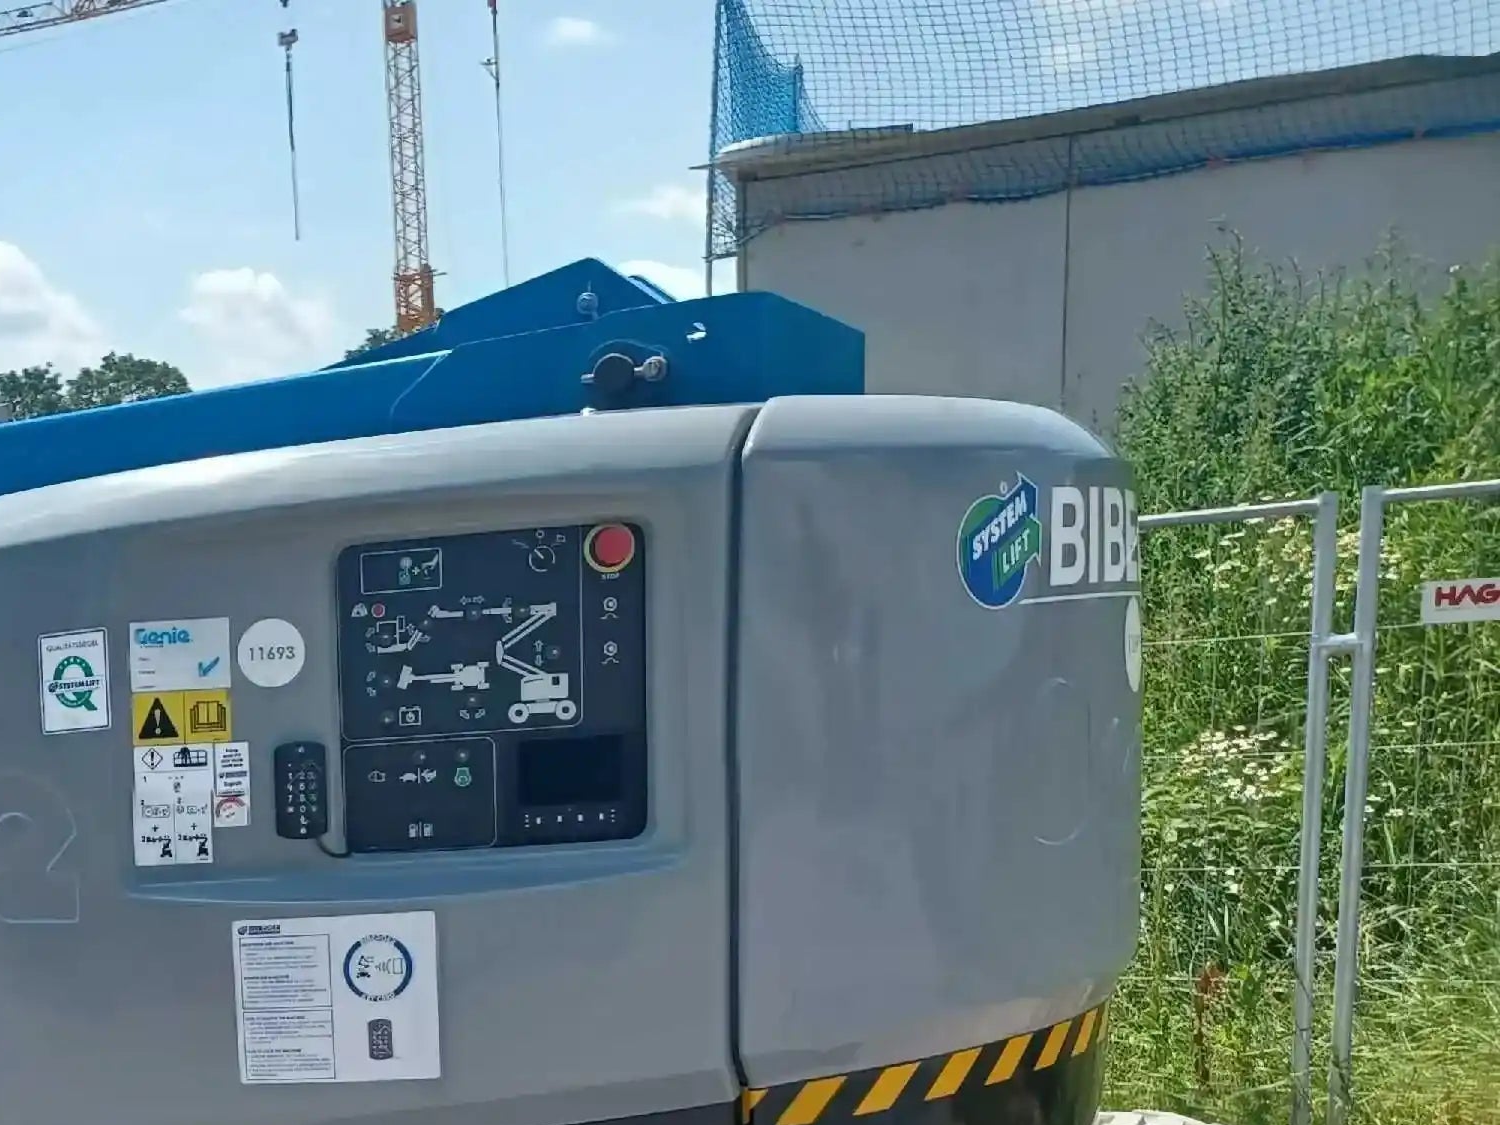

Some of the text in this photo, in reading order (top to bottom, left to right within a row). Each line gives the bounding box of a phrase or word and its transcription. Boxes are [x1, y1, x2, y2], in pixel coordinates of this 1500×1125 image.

[972, 490, 1028, 561] SYSTEM
[1002, 528, 1031, 572] LIFT
[134, 625, 191, 645] Genie
[248, 645, 296, 661] 11693
